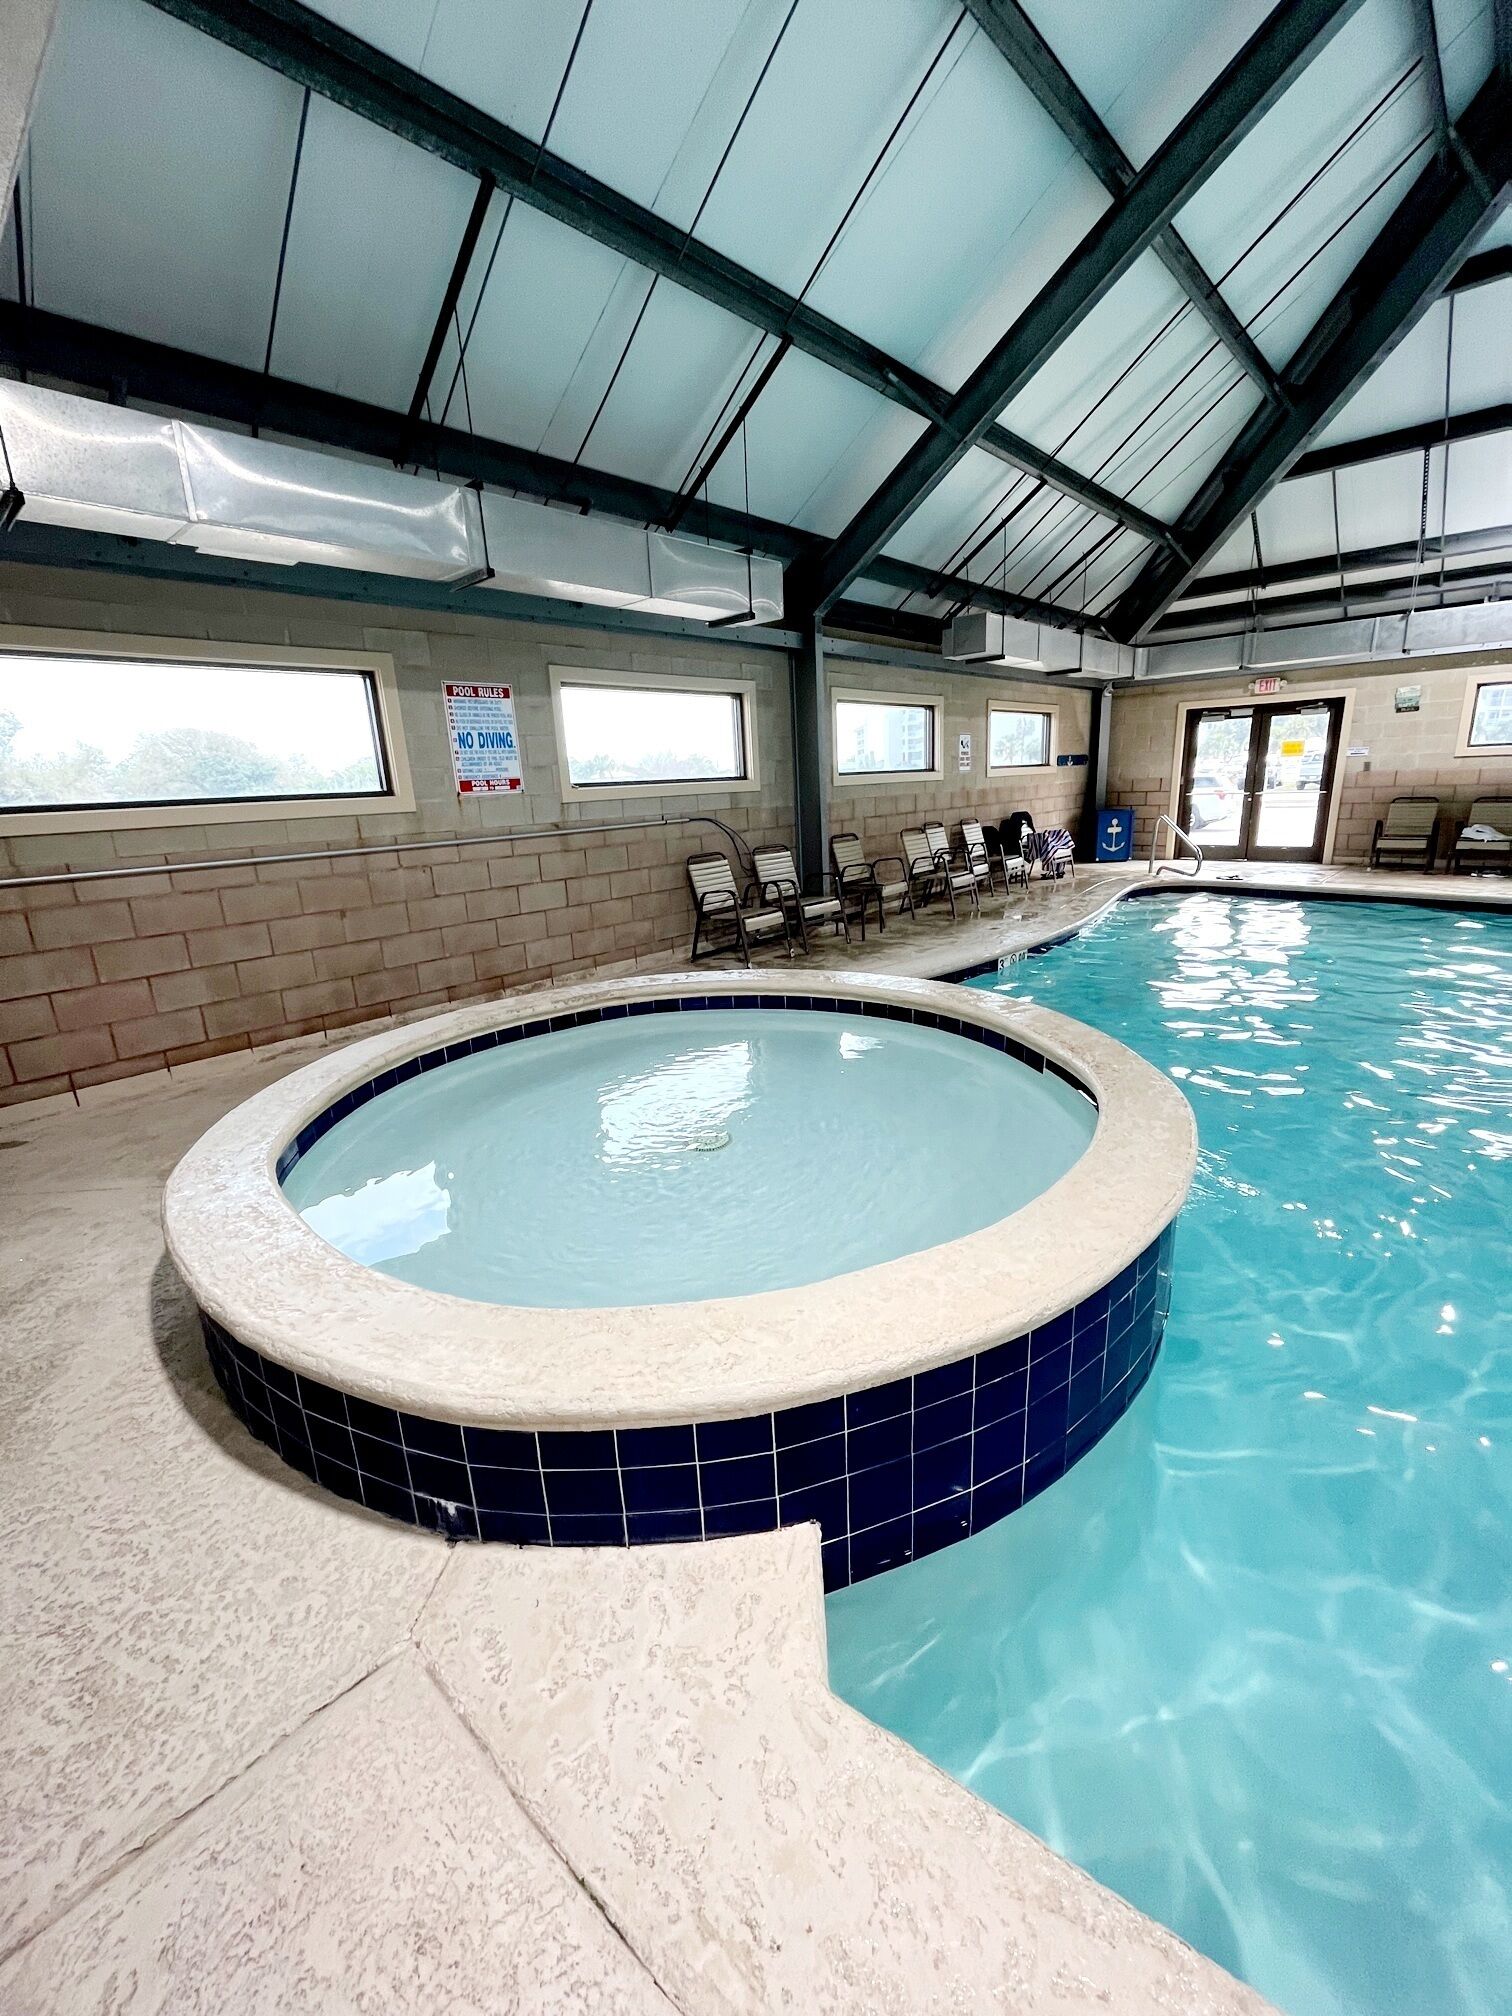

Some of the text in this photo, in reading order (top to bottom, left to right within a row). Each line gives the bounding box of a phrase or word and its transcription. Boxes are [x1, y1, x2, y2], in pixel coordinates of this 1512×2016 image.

[452, 686, 505, 698] POOL RULES
[457, 732, 474, 749] NO
